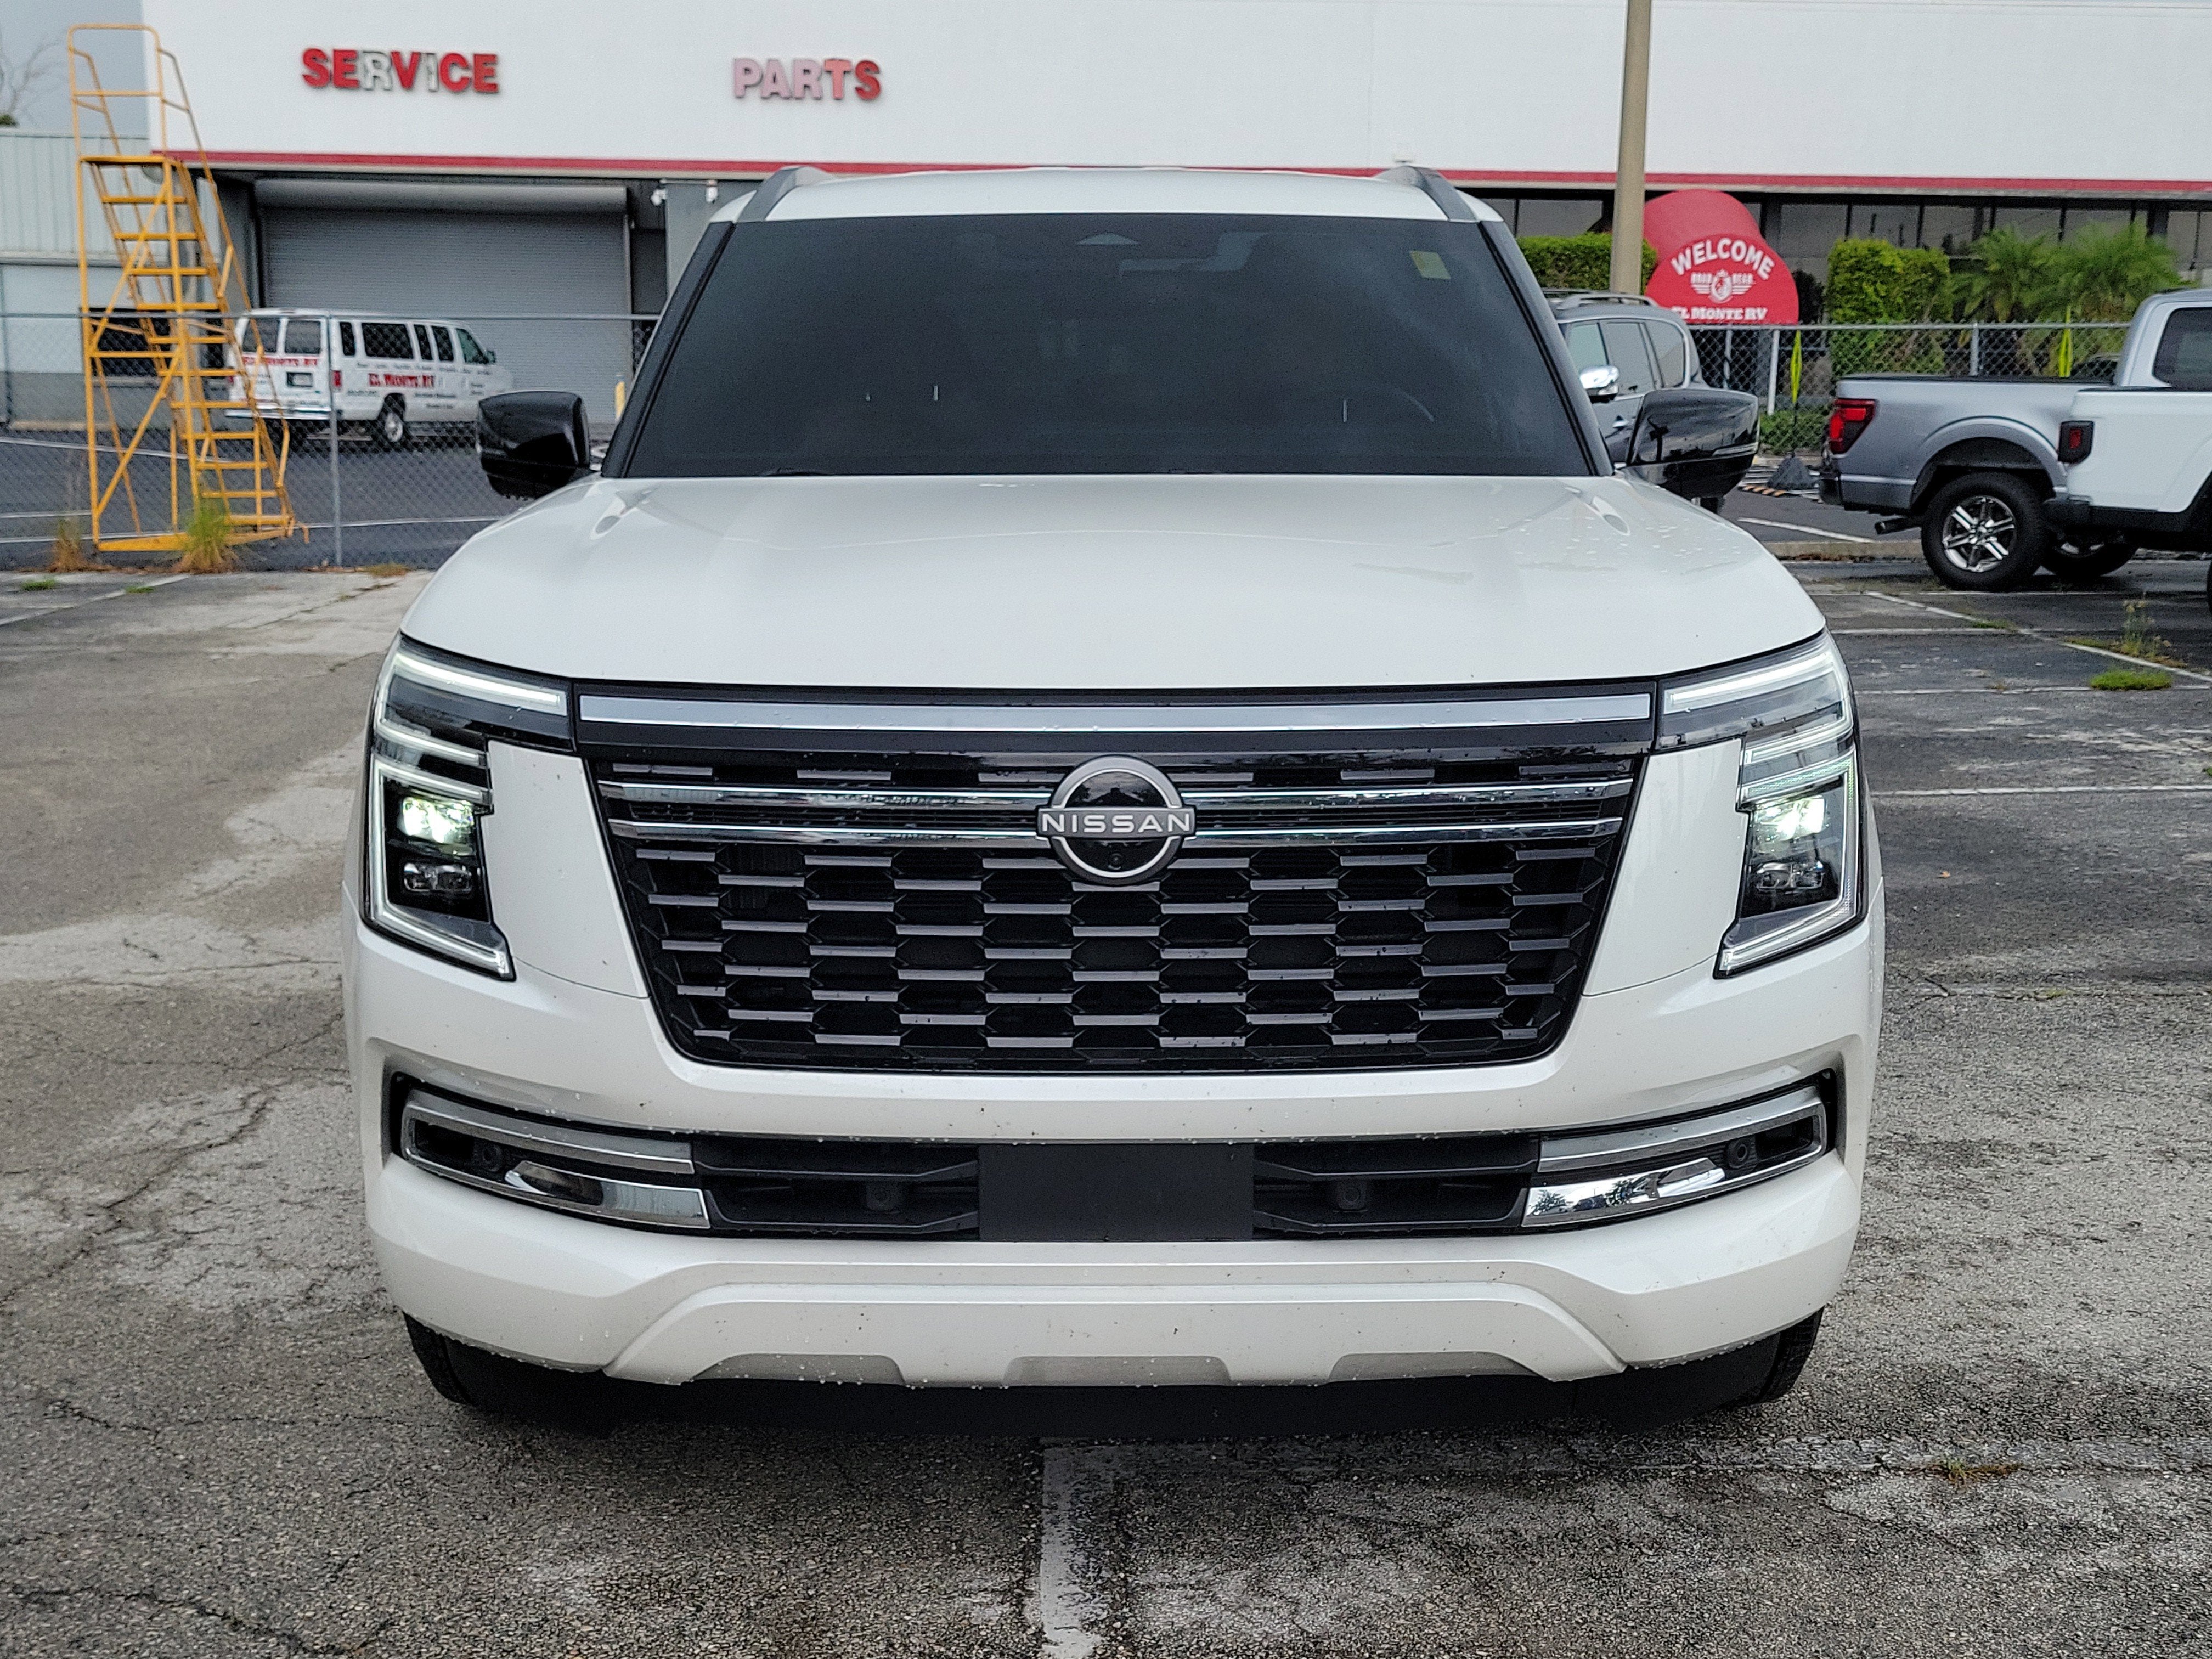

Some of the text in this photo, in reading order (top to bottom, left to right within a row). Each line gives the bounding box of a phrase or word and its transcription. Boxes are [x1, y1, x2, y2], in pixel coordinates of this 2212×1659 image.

[302, 48, 499, 93] SERVICE
[733, 58, 882, 101] PARTS
[1671, 238, 1775, 280] WELCOME
[1691, 306, 1744, 320] MONTE
[1744, 307, 1768, 320] RV
[1042, 813, 1190, 833] NISSAN
